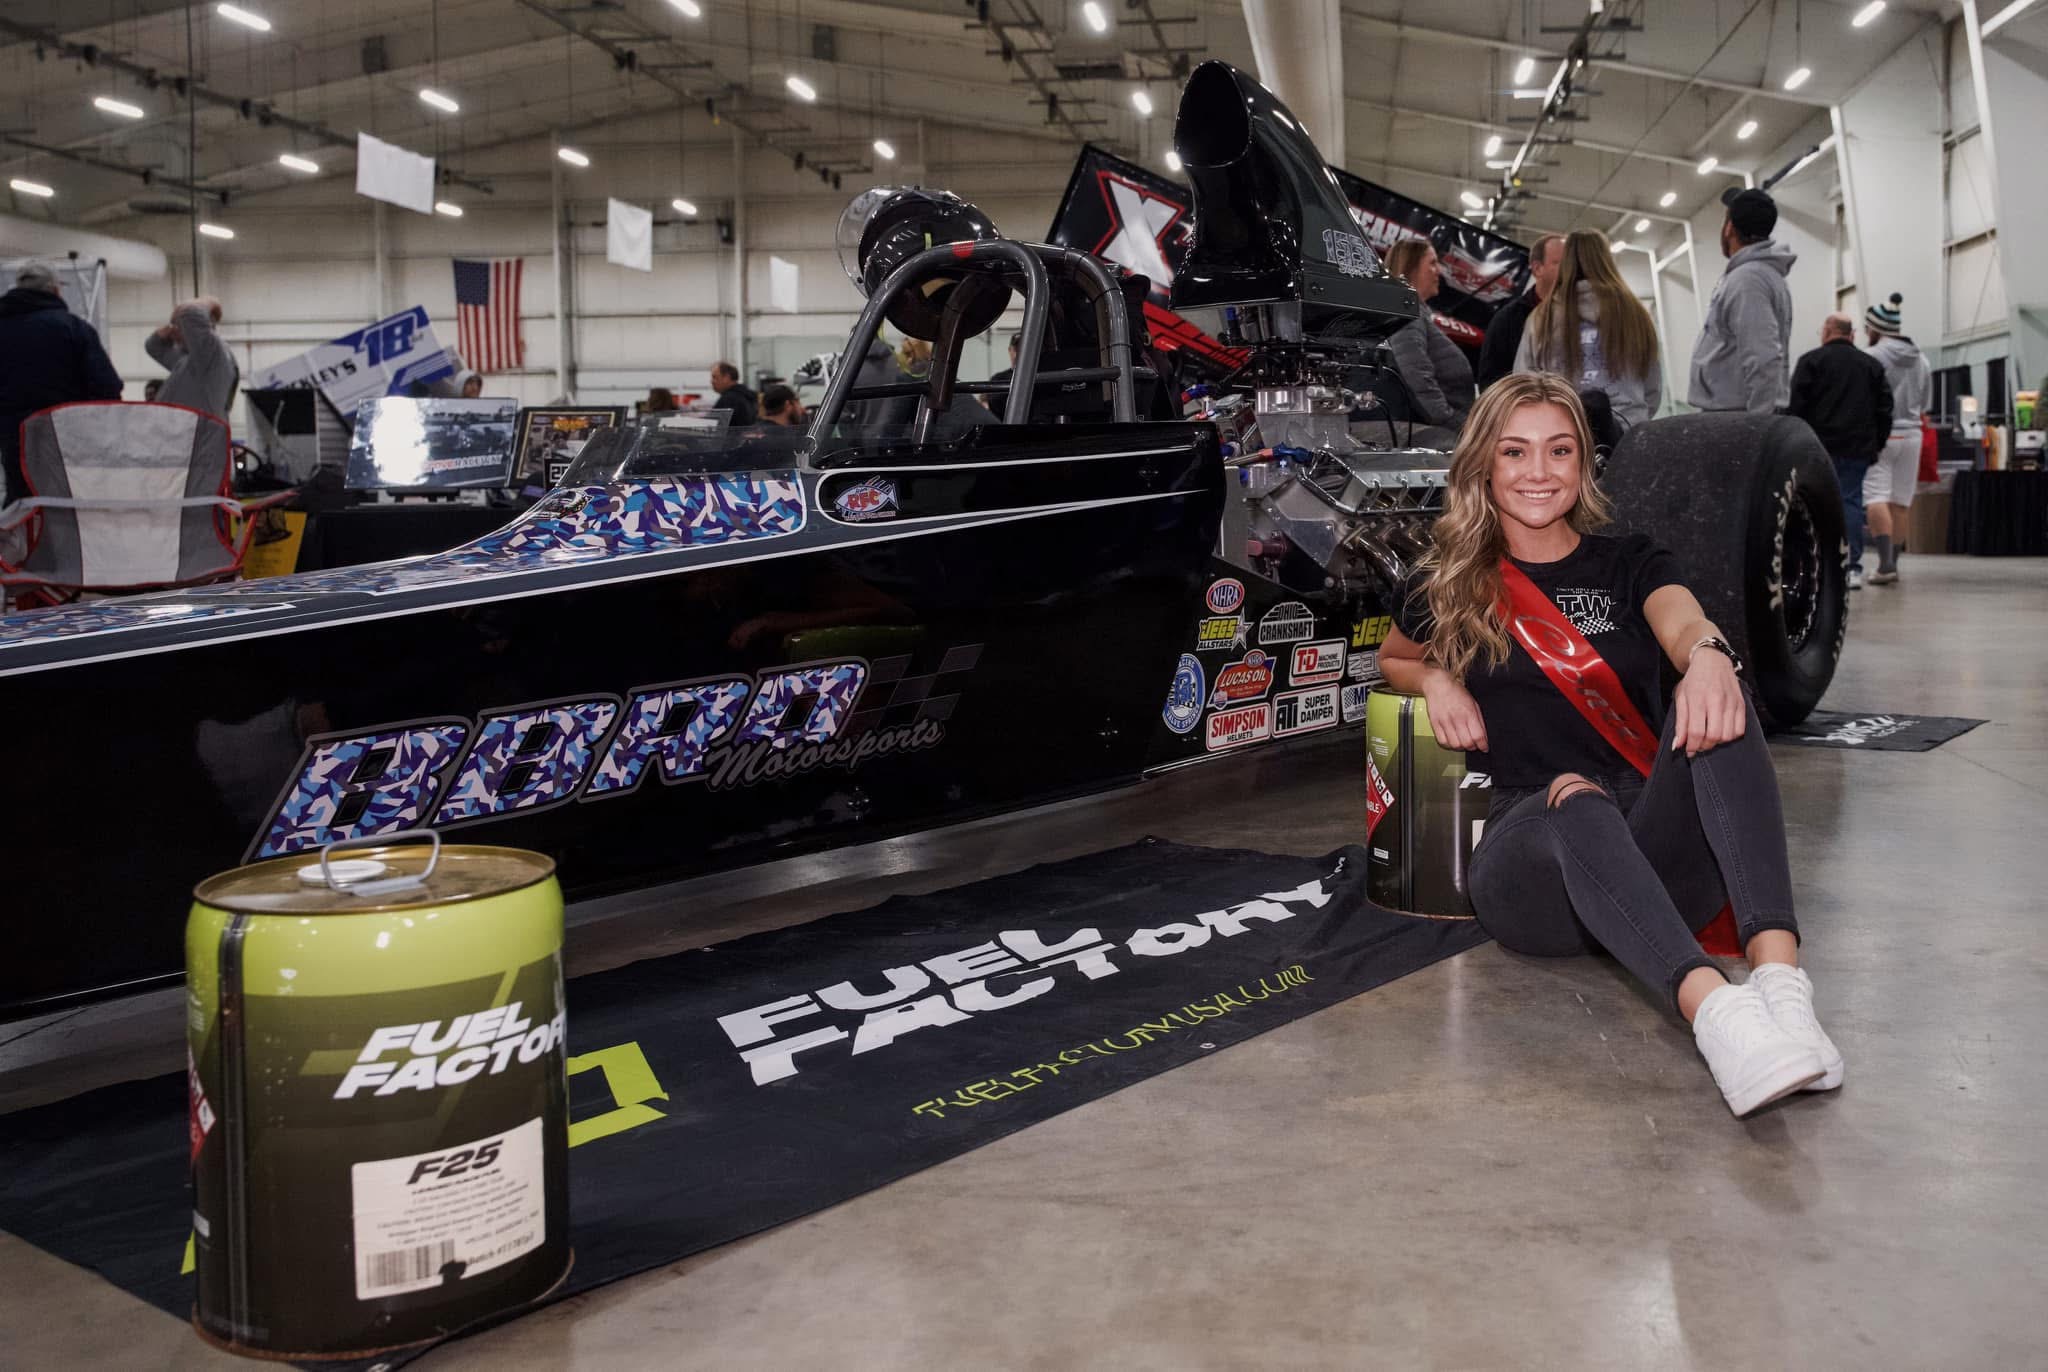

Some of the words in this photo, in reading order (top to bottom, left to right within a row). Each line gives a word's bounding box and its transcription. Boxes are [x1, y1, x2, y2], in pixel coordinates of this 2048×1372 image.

[363, 316, 415, 366] 18
[1212, 585, 1239, 607] NHRA
[1280, 603, 1298, 619] OHIO
[1201, 619, 1238, 640] JEGS
[1261, 622, 1313, 641] CRANKSHAFT
[1352, 616, 1391, 648] JEG
[1199, 640, 1233, 649] ALLSTARS
[1220, 671, 1251, 687] LUCAS
[1252, 669, 1267, 681] OIL
[1276, 696, 1299, 731] ATI
[1300, 706, 1334, 723] DAMPER
[1304, 694, 1331, 709] SUPER
[1211, 708, 1266, 738] SIMPSON
[1227, 731, 1254, 742] HELMETS
[706, 718, 945, 788] Motorsports
[716, 928, 1103, 1048] FUEL
[357, 1001, 532, 1062] FUEL
[333, 1009, 567, 1099] FACTOR
[406, 1140, 504, 1185] F25
